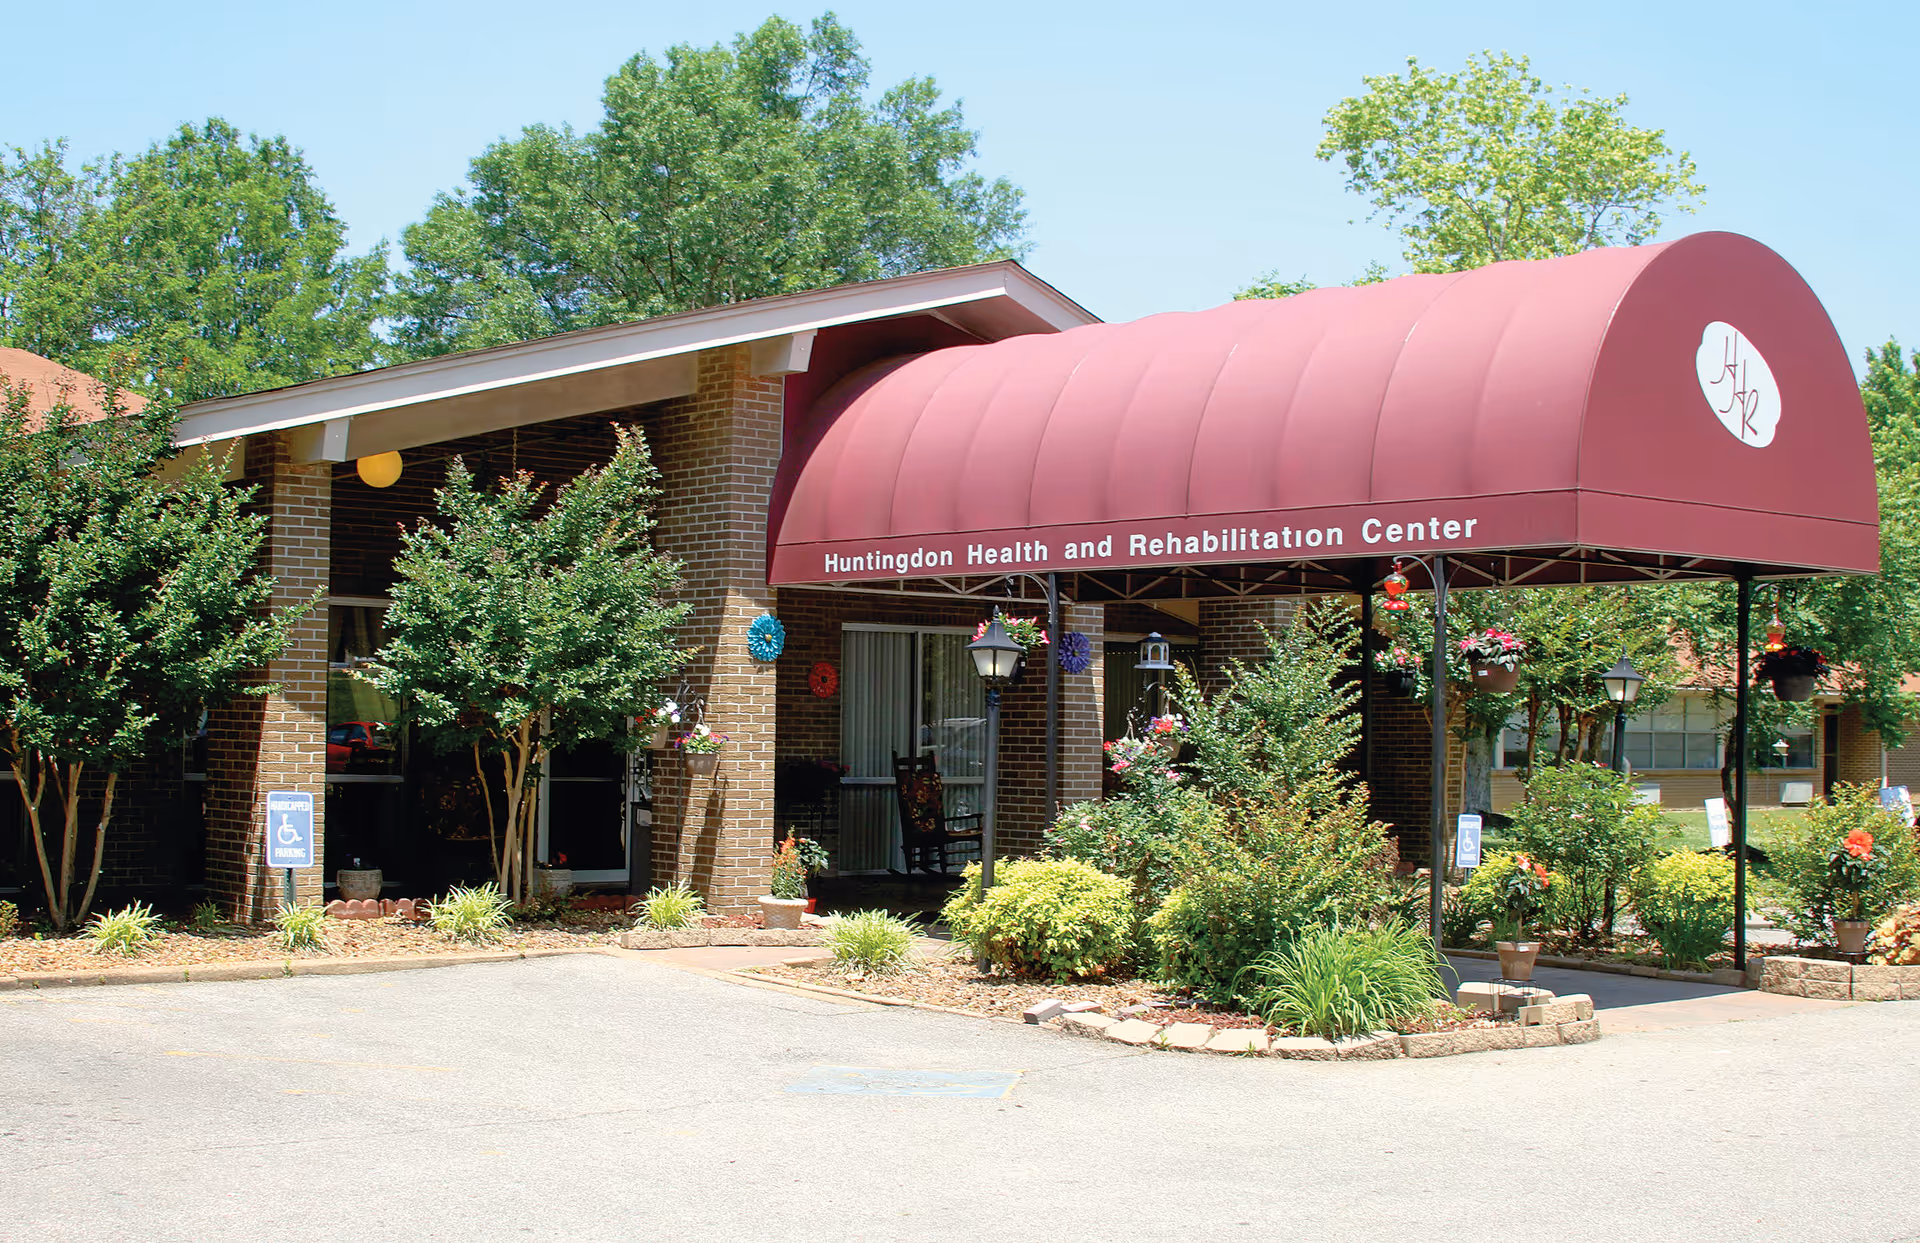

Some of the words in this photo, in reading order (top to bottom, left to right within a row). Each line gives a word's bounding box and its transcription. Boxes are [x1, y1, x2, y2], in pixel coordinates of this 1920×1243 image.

[824, 548, 953, 573] Huntingdon
[967, 540, 1048, 565] Health
[1065, 534, 1112, 560] and
[1129, 527, 1343, 557] Rehabilitation
[1362, 516, 1478, 544] Center
[275, 847, 306, 858] PARKING
